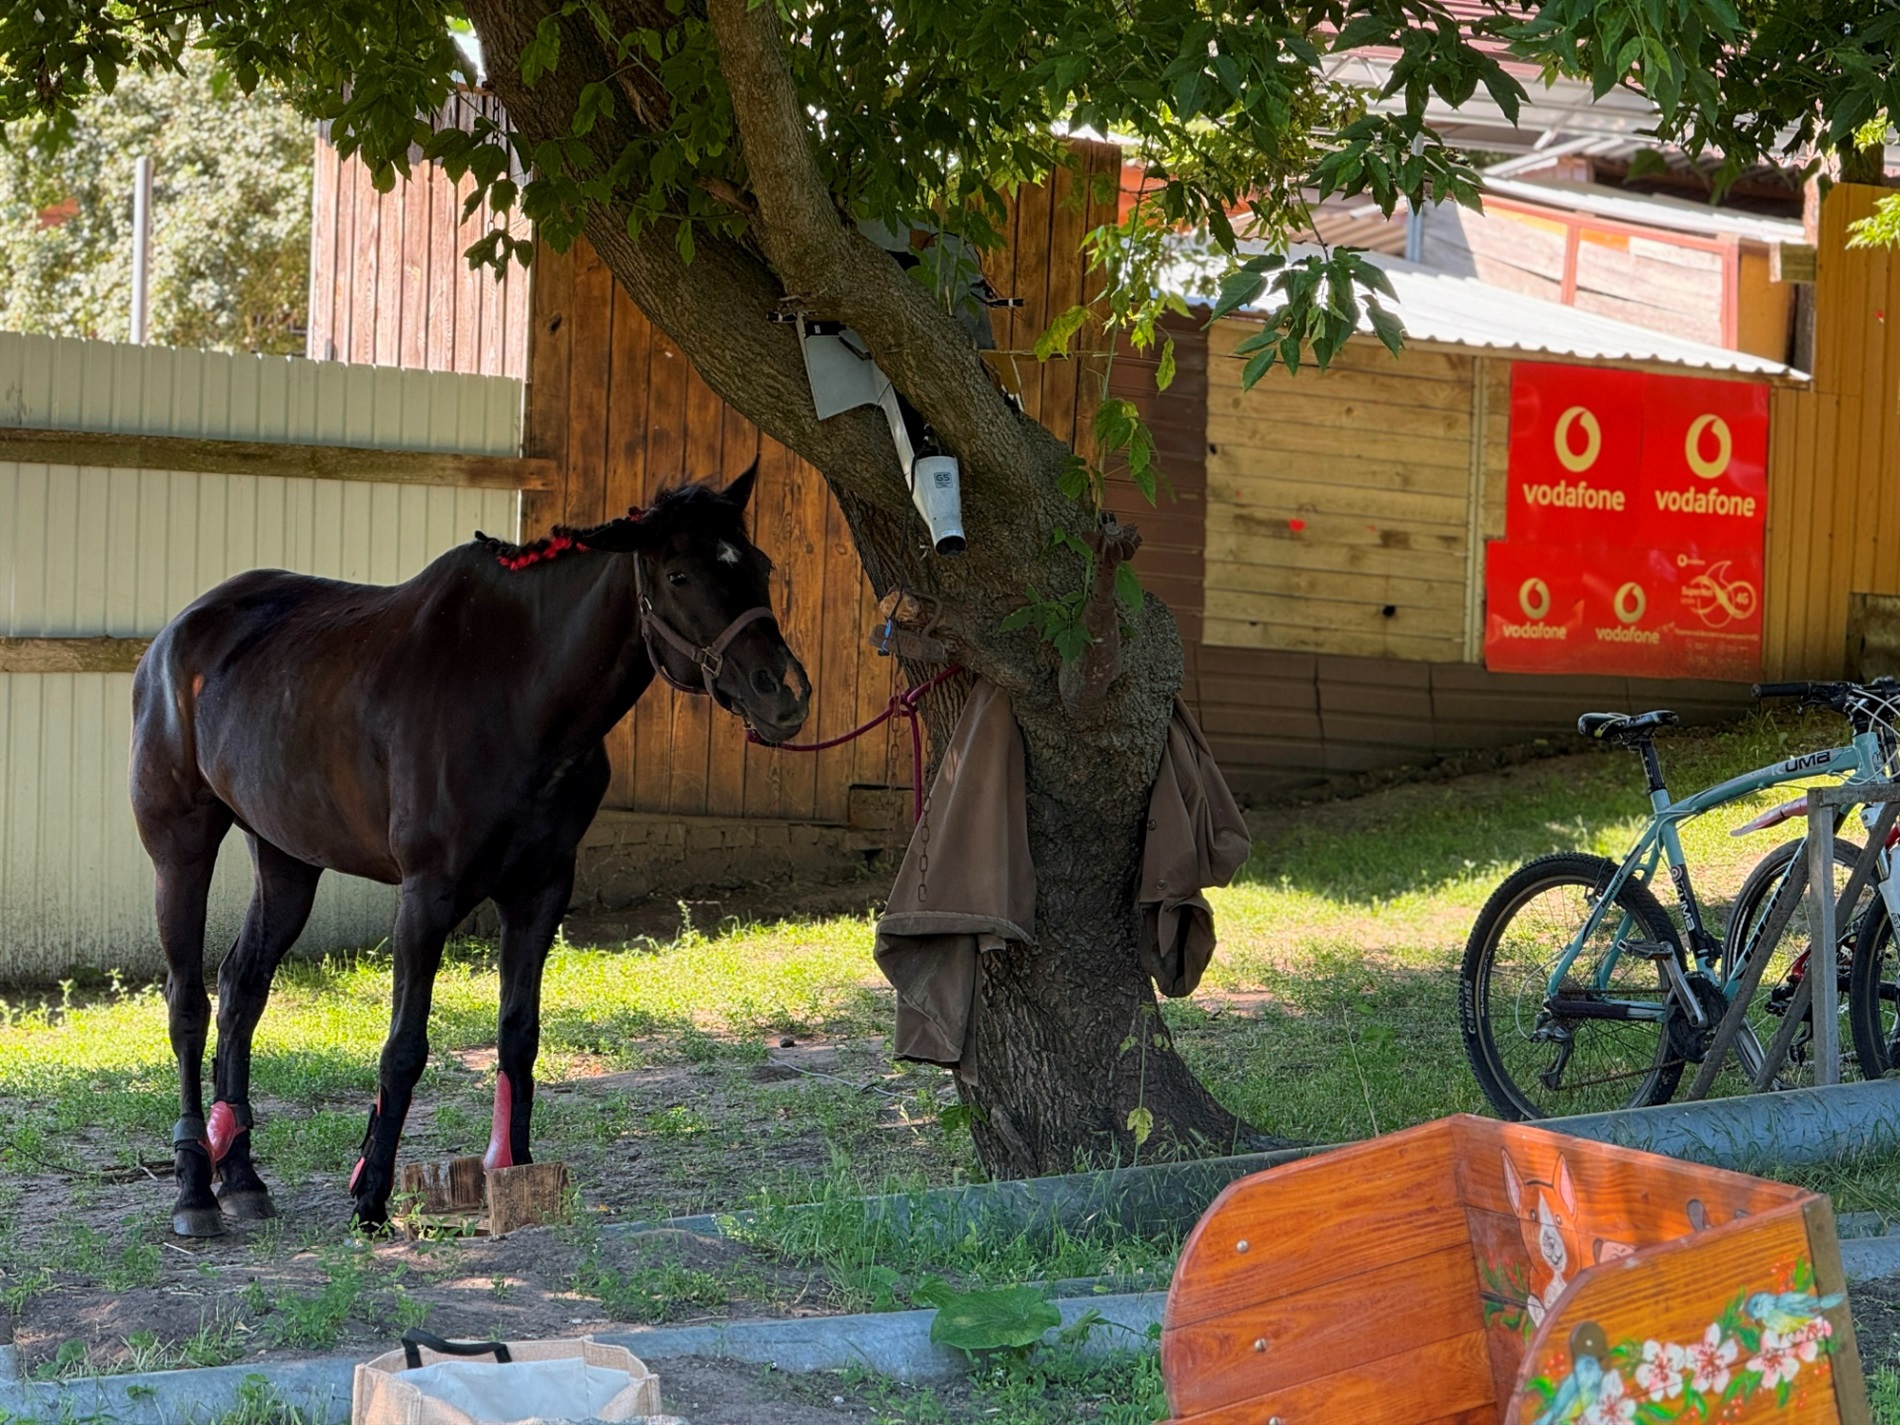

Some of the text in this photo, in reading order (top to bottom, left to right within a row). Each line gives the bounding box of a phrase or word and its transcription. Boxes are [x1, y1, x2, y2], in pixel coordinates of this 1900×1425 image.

[1523, 480, 1625, 511] vodafone
[1655, 487, 1755, 517] vodafone
[1503, 621, 1567, 640] vodafone
[1596, 625, 1660, 644] vodafone
